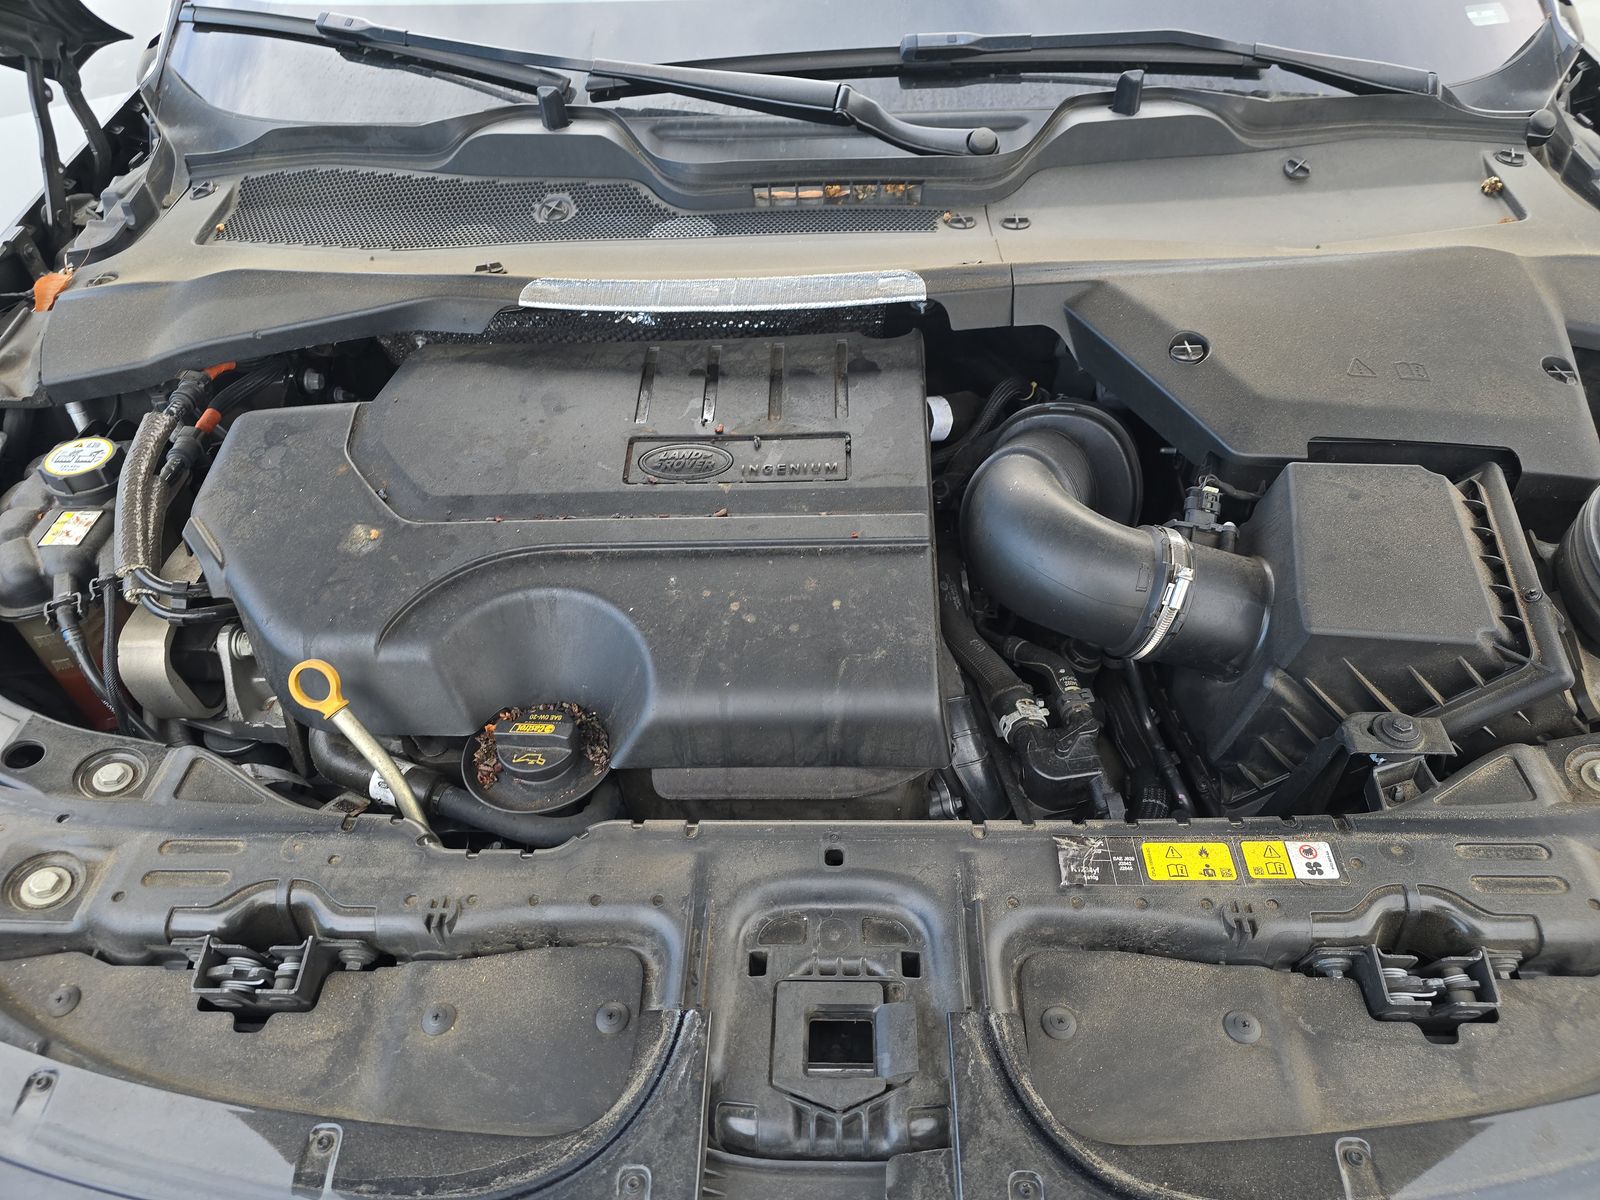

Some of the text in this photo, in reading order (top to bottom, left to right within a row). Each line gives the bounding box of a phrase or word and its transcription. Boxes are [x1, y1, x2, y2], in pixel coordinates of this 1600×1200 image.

[658, 450, 703, 460] LAND
[660, 459, 715, 472] ROVER
[741, 462, 838, 476] INGENIUM
[516, 724, 545, 732] Castrol
